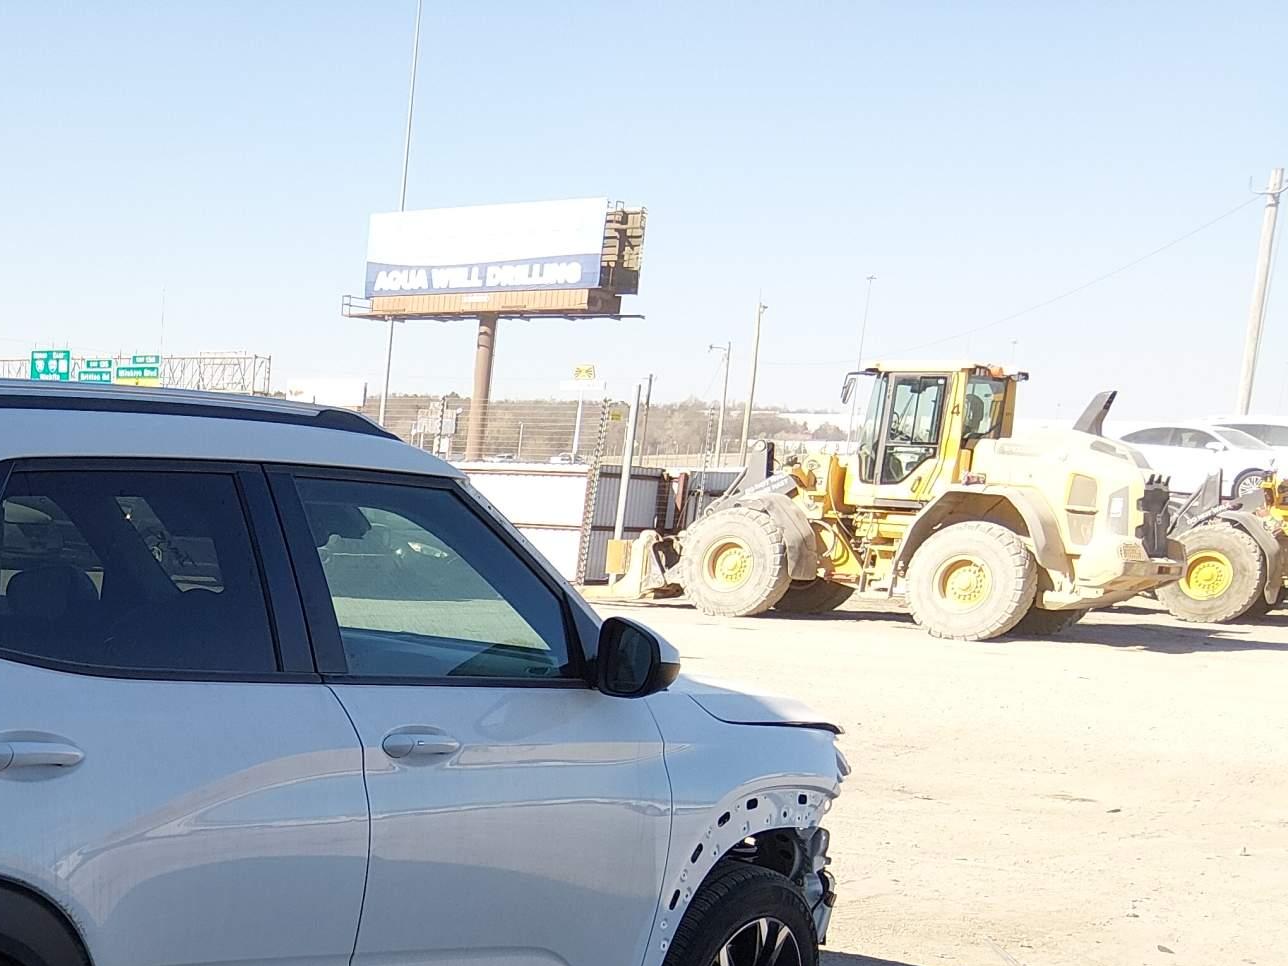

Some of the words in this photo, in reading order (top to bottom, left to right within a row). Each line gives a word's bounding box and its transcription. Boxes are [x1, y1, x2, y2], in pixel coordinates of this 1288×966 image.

[374, 269, 428, 291] AQUA
[431, 266, 483, 288] WELL
[486, 261, 582, 287] DRILLING
[951, 403, 960, 416] 4
